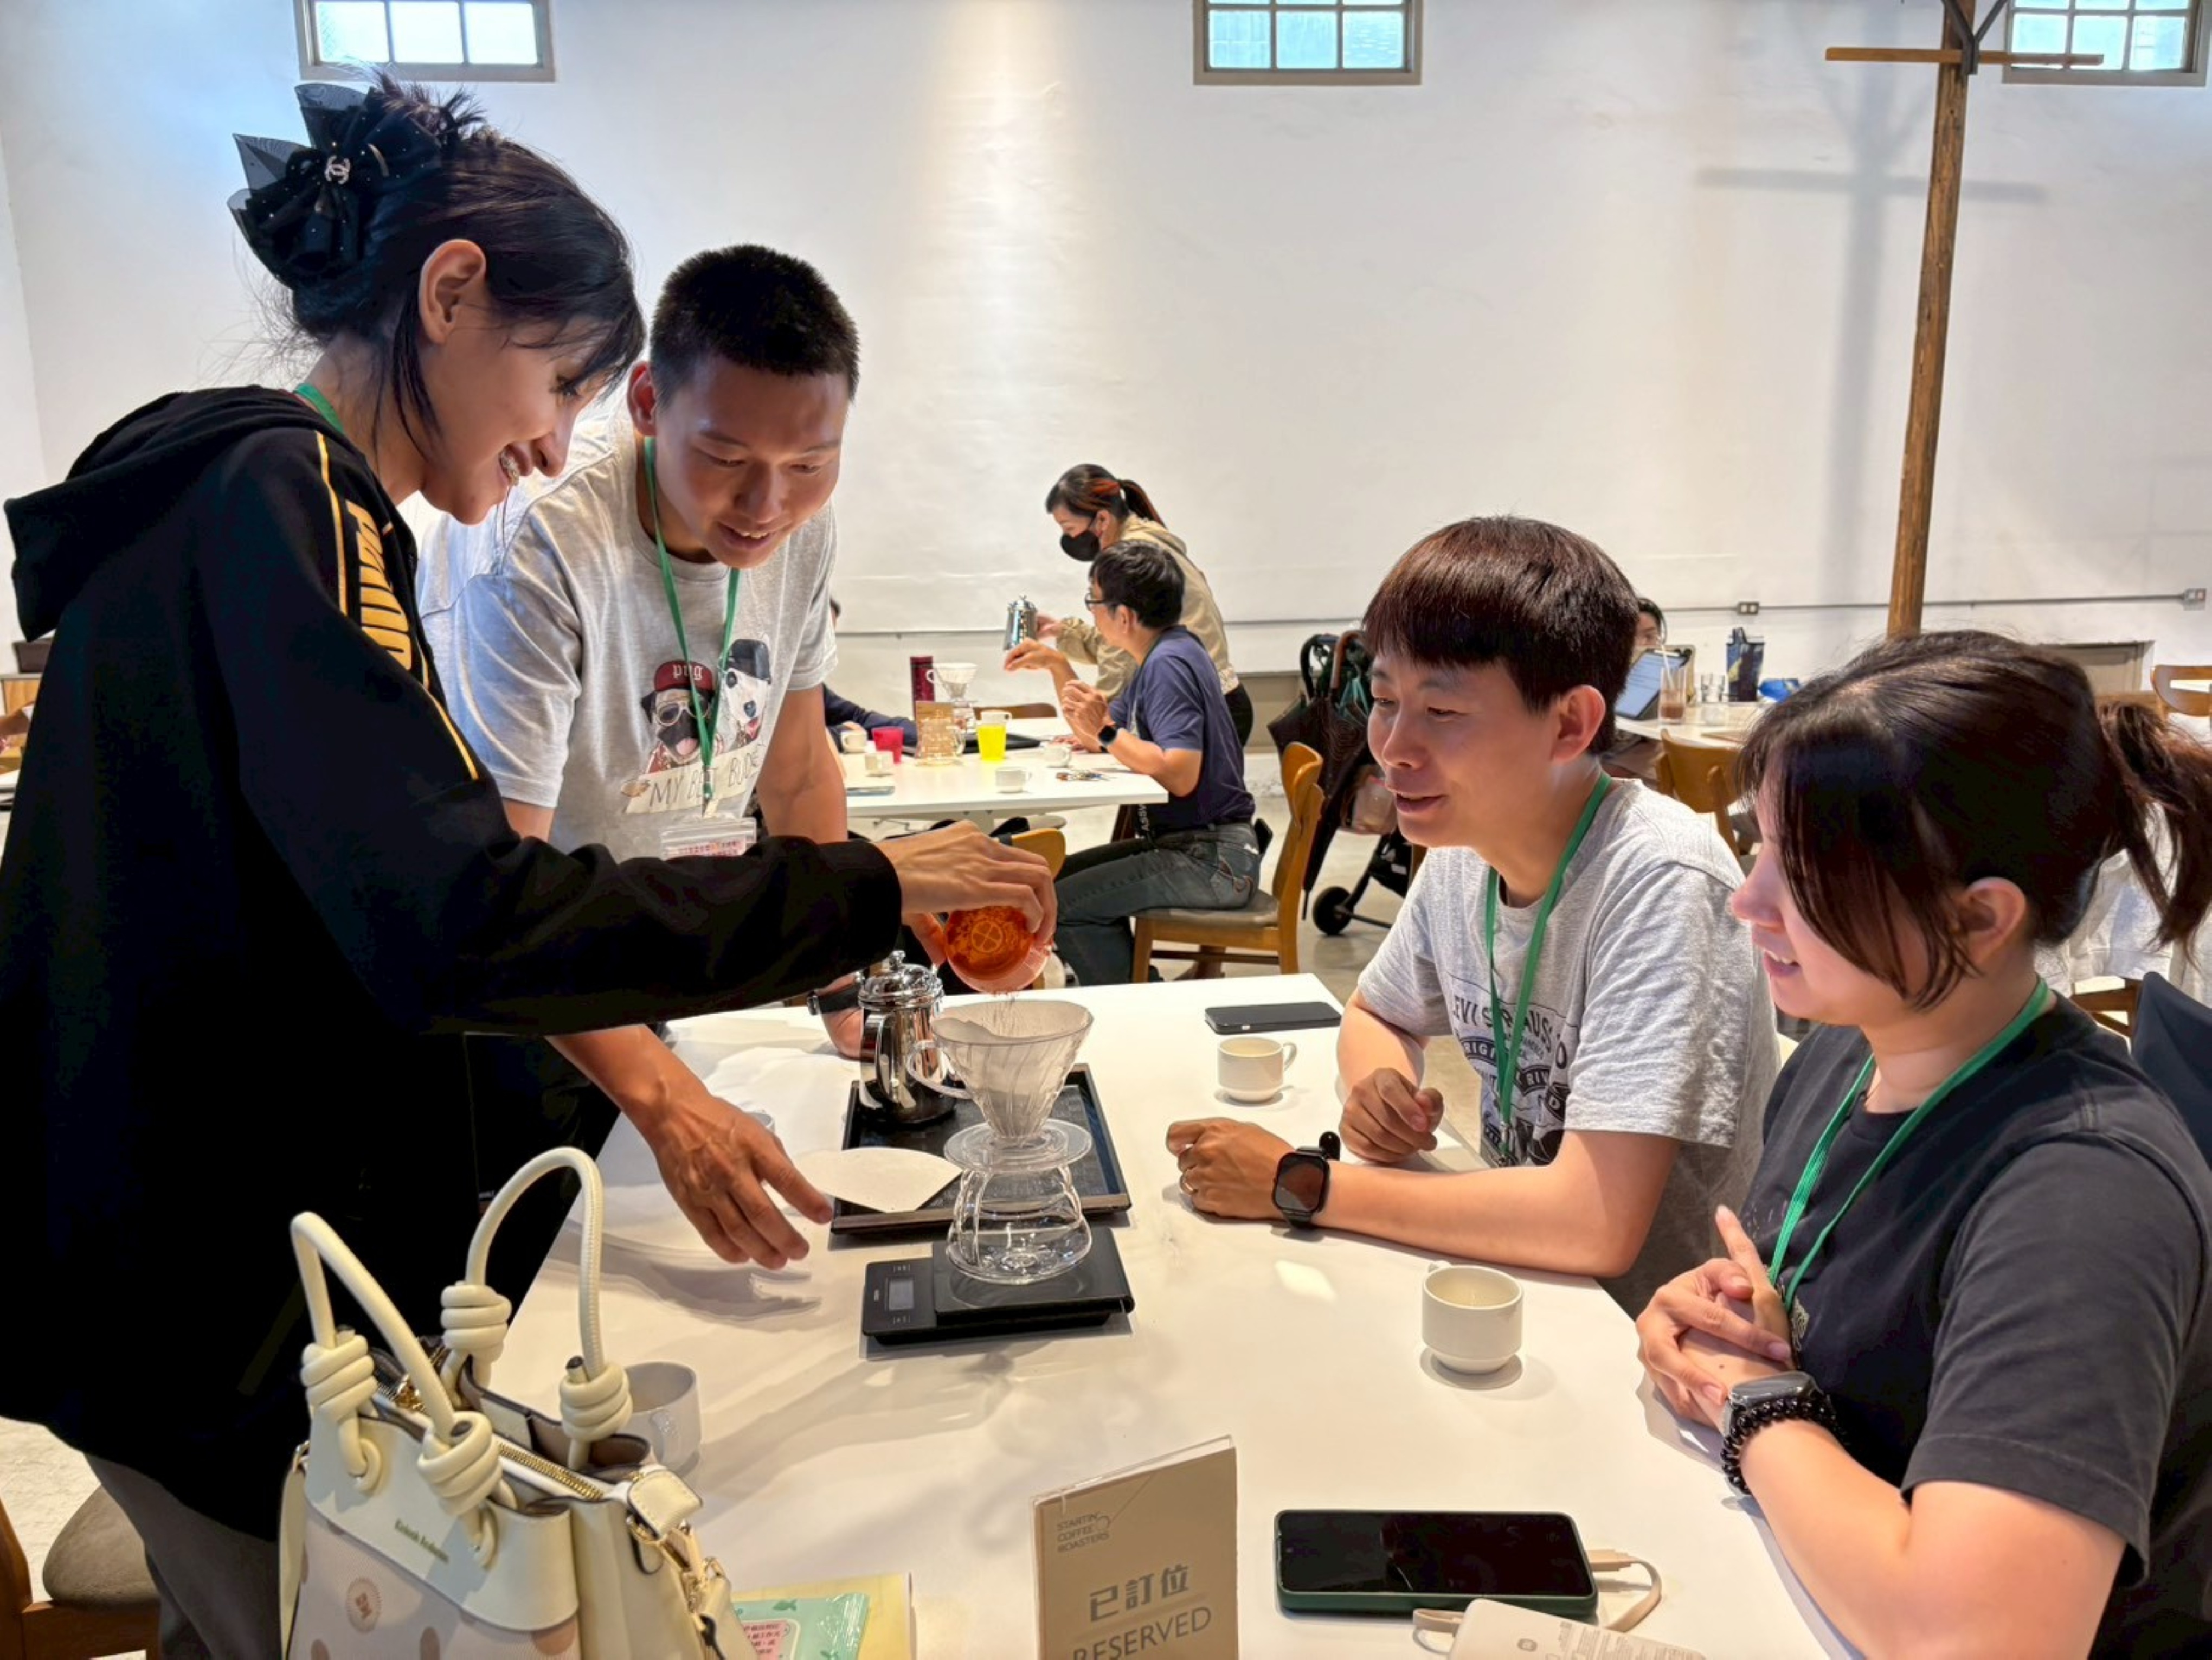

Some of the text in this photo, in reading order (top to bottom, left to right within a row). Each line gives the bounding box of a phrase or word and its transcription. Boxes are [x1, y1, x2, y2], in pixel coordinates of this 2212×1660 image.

[649, 774, 684, 807] MY
[1089, 1564, 1189, 1623] 已訂位
